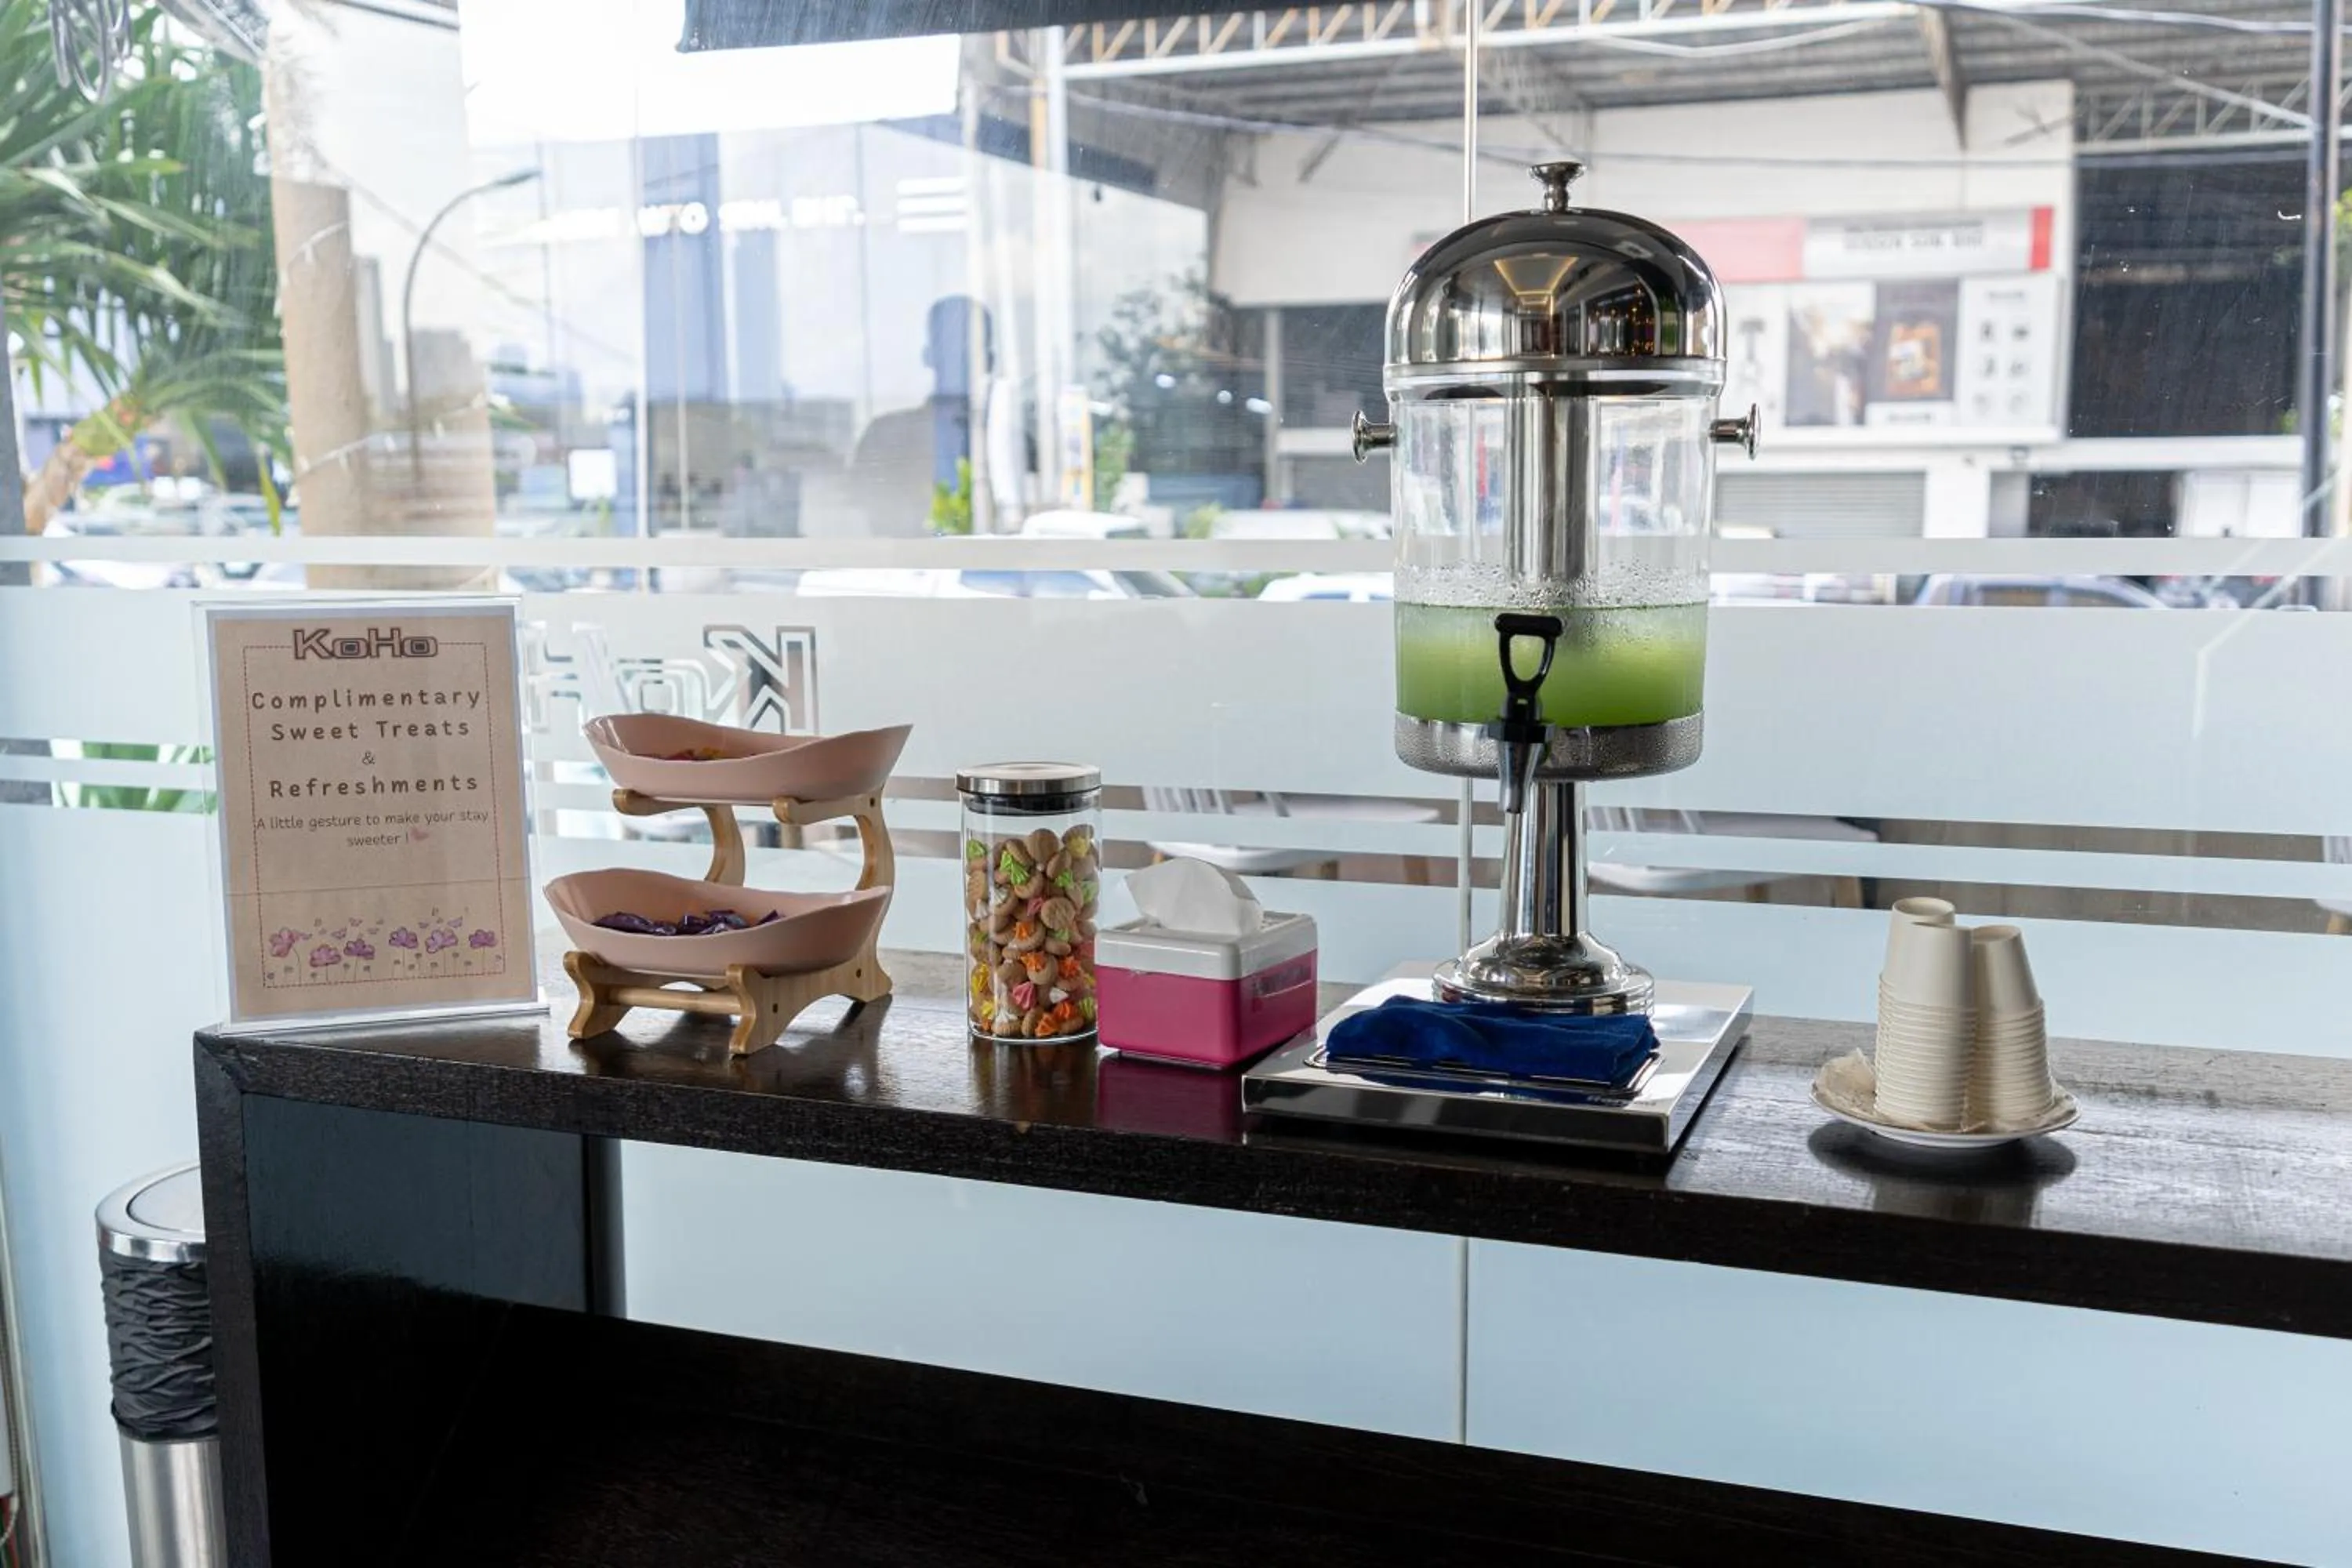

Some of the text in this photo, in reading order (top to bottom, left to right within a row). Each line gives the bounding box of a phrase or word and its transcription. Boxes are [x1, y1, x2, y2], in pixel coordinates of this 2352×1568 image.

[293, 627, 438, 659] KoHo
[252, 688, 481, 713] Complimentary
[271, 720, 470, 742] Sweet Treats
[361, 750, 376, 765] &
[270, 775, 477, 798] Refreshments
[256, 809, 488, 832] A little gesture to make your stay
[347, 834, 401, 847] sweeter
